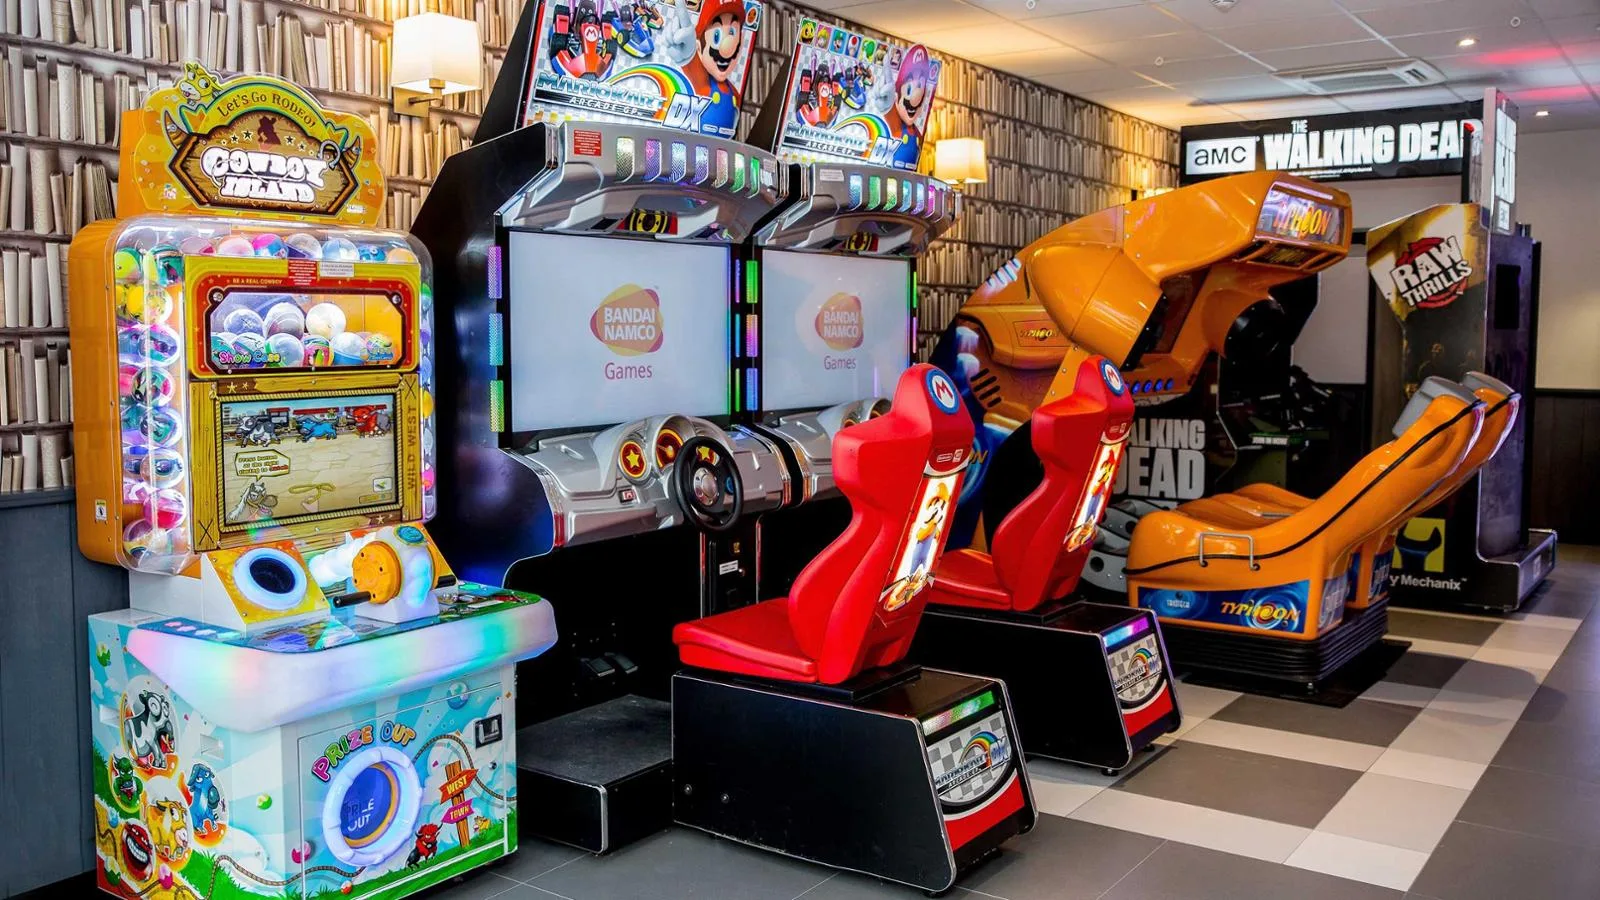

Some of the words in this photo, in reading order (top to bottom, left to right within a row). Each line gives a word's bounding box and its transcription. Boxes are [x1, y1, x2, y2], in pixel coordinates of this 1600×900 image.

[217, 94, 249, 118] Let's
[251, 91, 267, 103] Go
[569, 96, 621, 113] ARCADE
[662, 92, 713, 132] DX
[1291, 120, 1308, 133] THE
[1263, 124, 1395, 170] WALKING
[201, 146, 328, 191] COWBOY
[220, 175, 315, 203] ISLAND
[1389, 235, 1463, 295] RAW
[1402, 260, 1473, 307] THRILLS
[604, 307, 656, 323] BANDAI
[823, 311, 859, 324] BANDAI
[604, 325, 656, 340] NAMCO
[823, 325, 859, 338] NAMCO
[219, 350, 251, 365] Show
[252, 350, 281, 364] Case
[823, 355, 857, 370] Games
[604, 362, 653, 380] Games
[407, 407, 417, 447] WEST
[1127, 418, 1206, 450] ALKING
[407, 455, 417, 490] WILD
[1400, 574, 1461, 591] Mechanix
[1220, 601, 1302, 623] TYPHOON
[312, 725, 374, 782] PRIZE
[380, 720, 416, 747] OUT
[446, 775, 468, 795] WEST
[449, 805, 470, 821] TOWN
